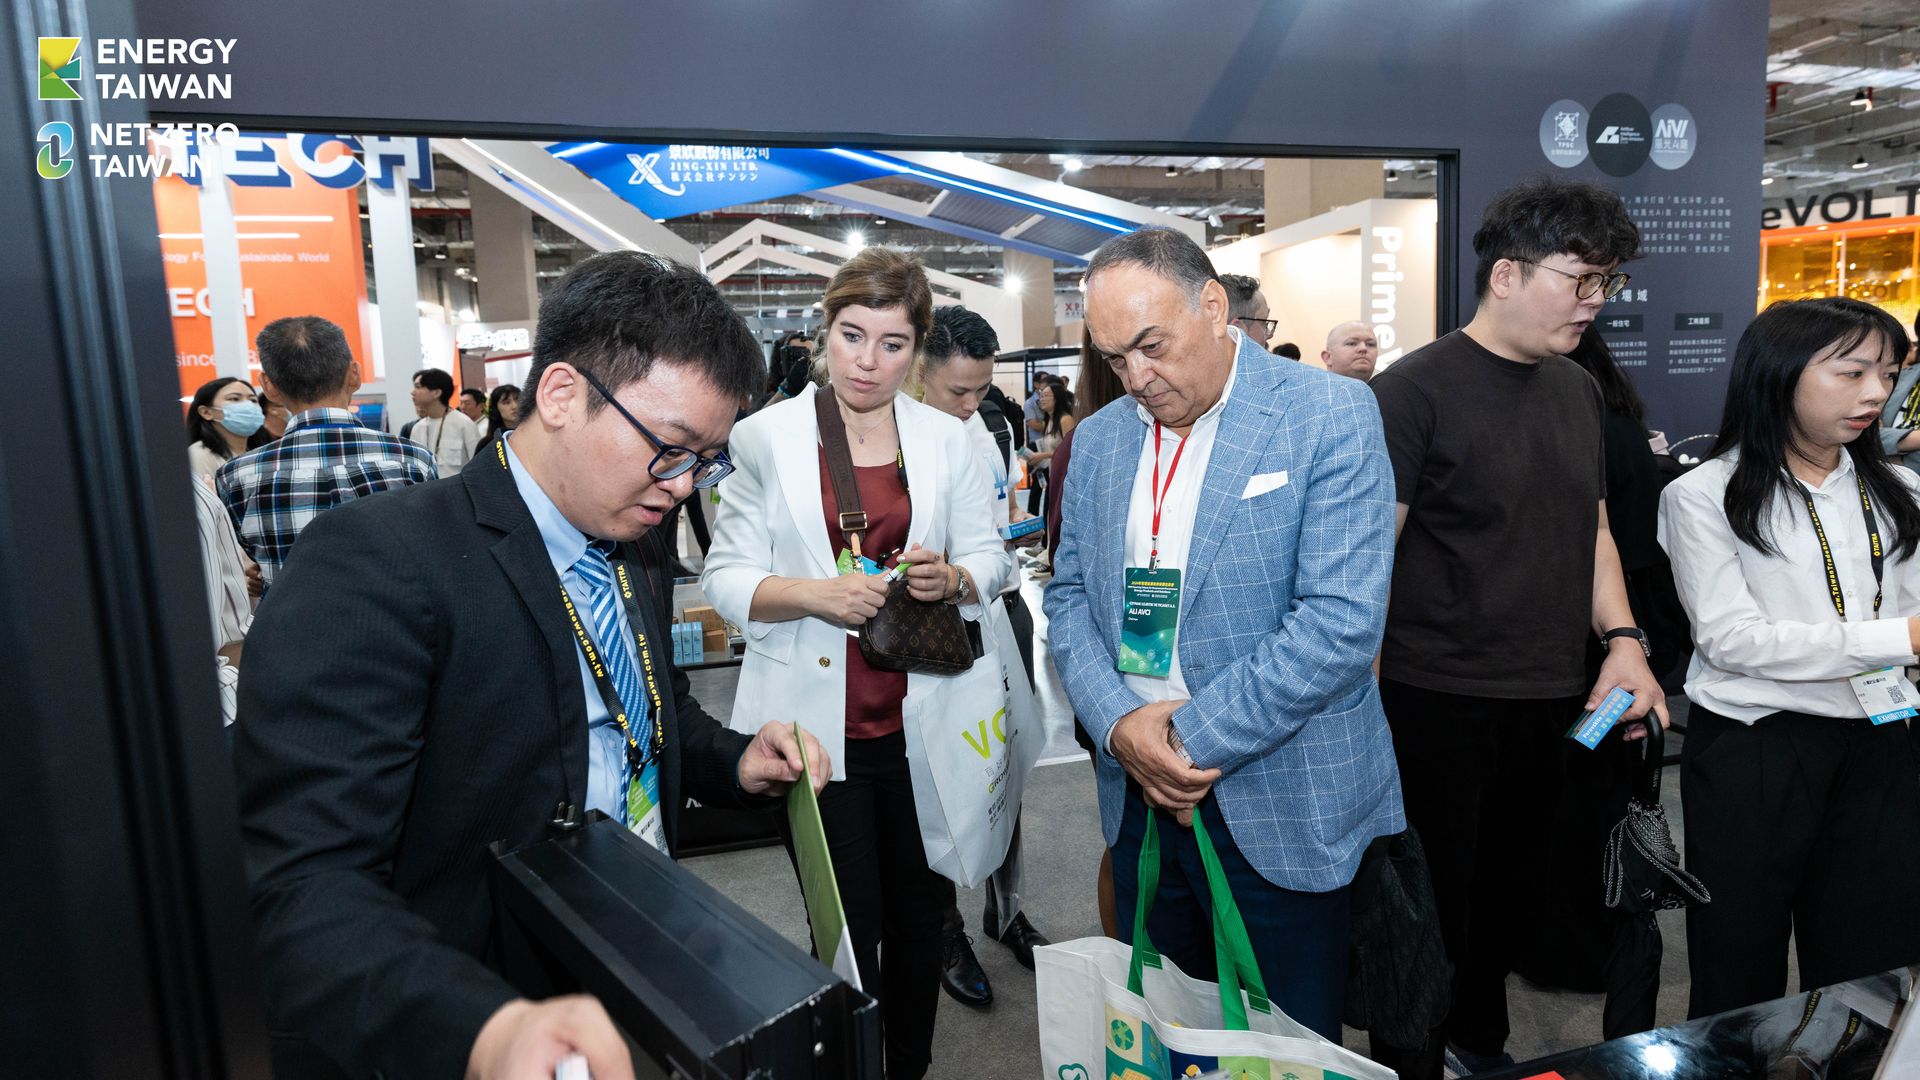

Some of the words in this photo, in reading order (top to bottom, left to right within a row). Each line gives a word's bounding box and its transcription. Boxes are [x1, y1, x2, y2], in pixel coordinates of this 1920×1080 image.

[670, 162, 727, 171] JING-XIN
[733, 162, 759, 171] LTD.
[239, 252, 293, 262] ustainable
[297, 252, 330, 262] World
[617, 565, 630, 592] TAITRA
[1876, 709, 1911, 724] EXHIBITOR
